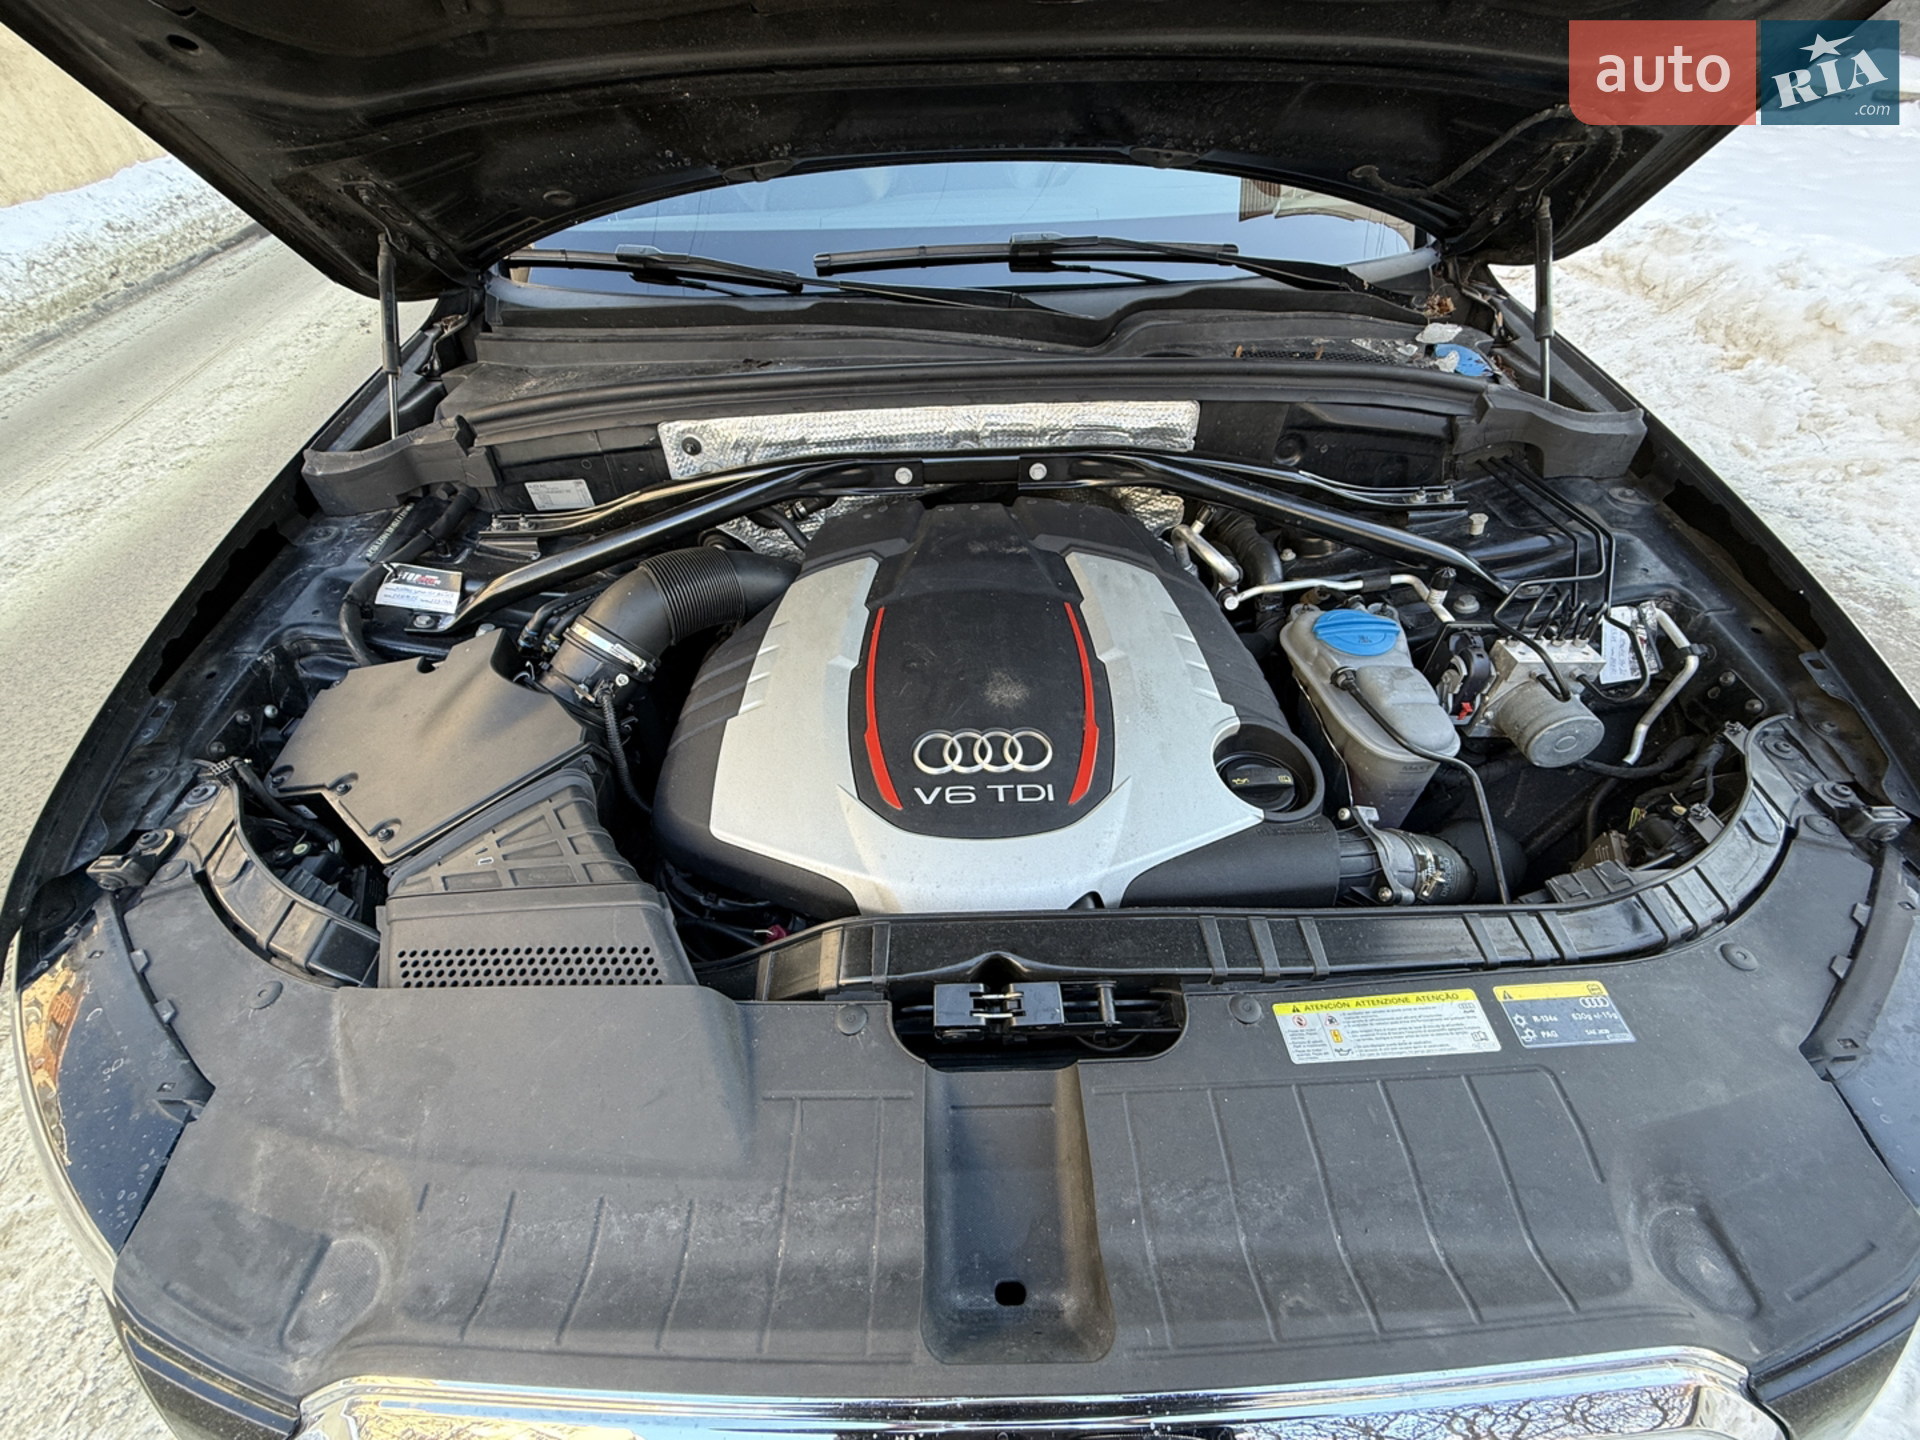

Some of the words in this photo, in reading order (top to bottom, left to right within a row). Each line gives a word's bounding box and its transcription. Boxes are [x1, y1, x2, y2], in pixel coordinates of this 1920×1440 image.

[913, 785, 977, 805] V6
[986, 783, 1055, 802] TDI
[1304, 1000, 1351, 1012] ATENCIÓN
[1355, 996, 1411, 1008] ATTENZIONE
[1415, 992, 1460, 1004] ATENÇÃO
[1540, 1030, 1559, 1039] PAG
